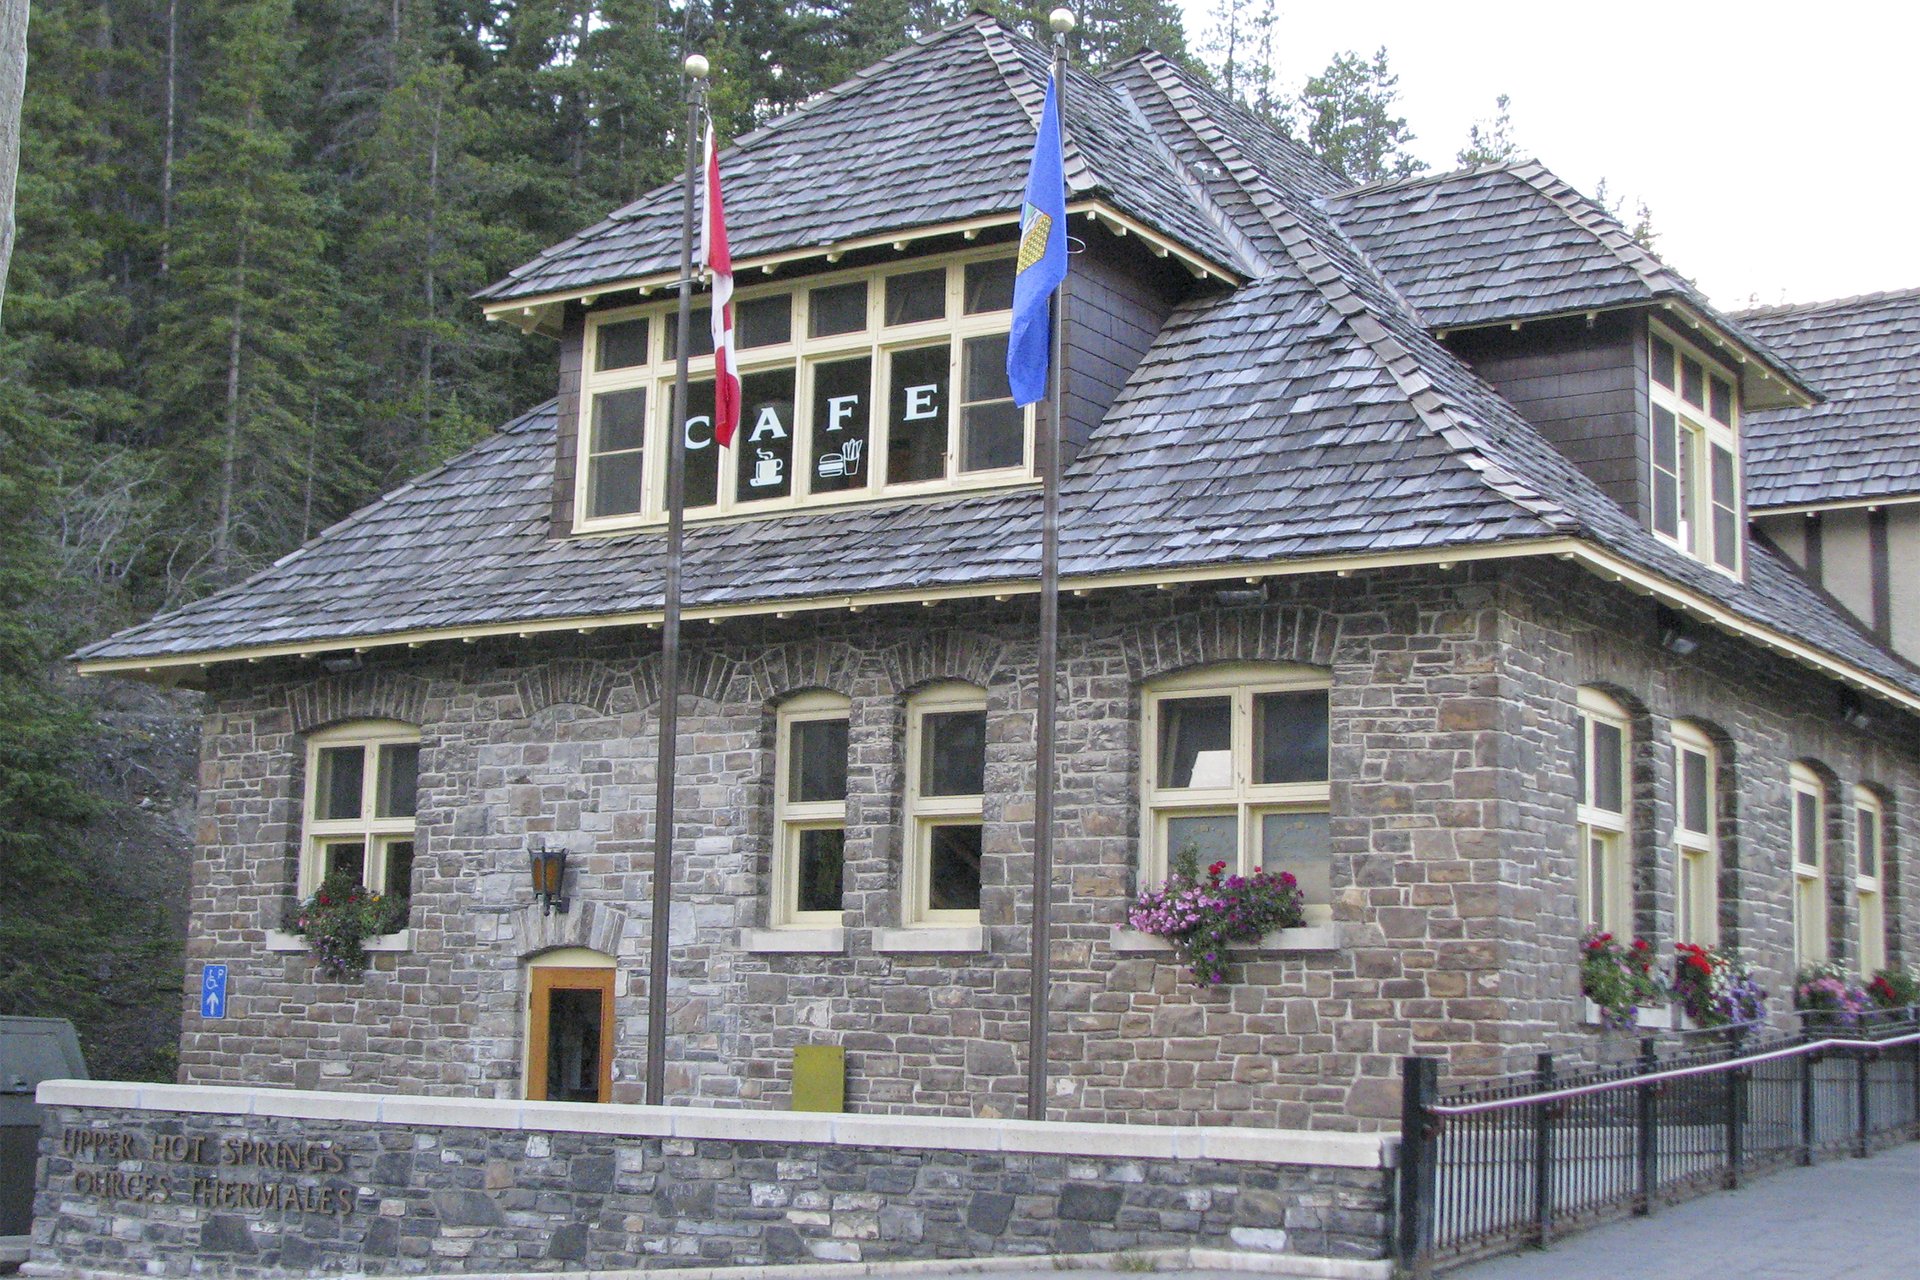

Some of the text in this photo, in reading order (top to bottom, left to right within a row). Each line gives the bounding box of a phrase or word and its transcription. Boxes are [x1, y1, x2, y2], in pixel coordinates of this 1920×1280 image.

[684, 383, 939, 450] CAFE
[217, 969, 225, 979] P
[63, 1128, 344, 1173] UPPER HOT SPRINGS
[189, 1177, 354, 1216] THERMALES
